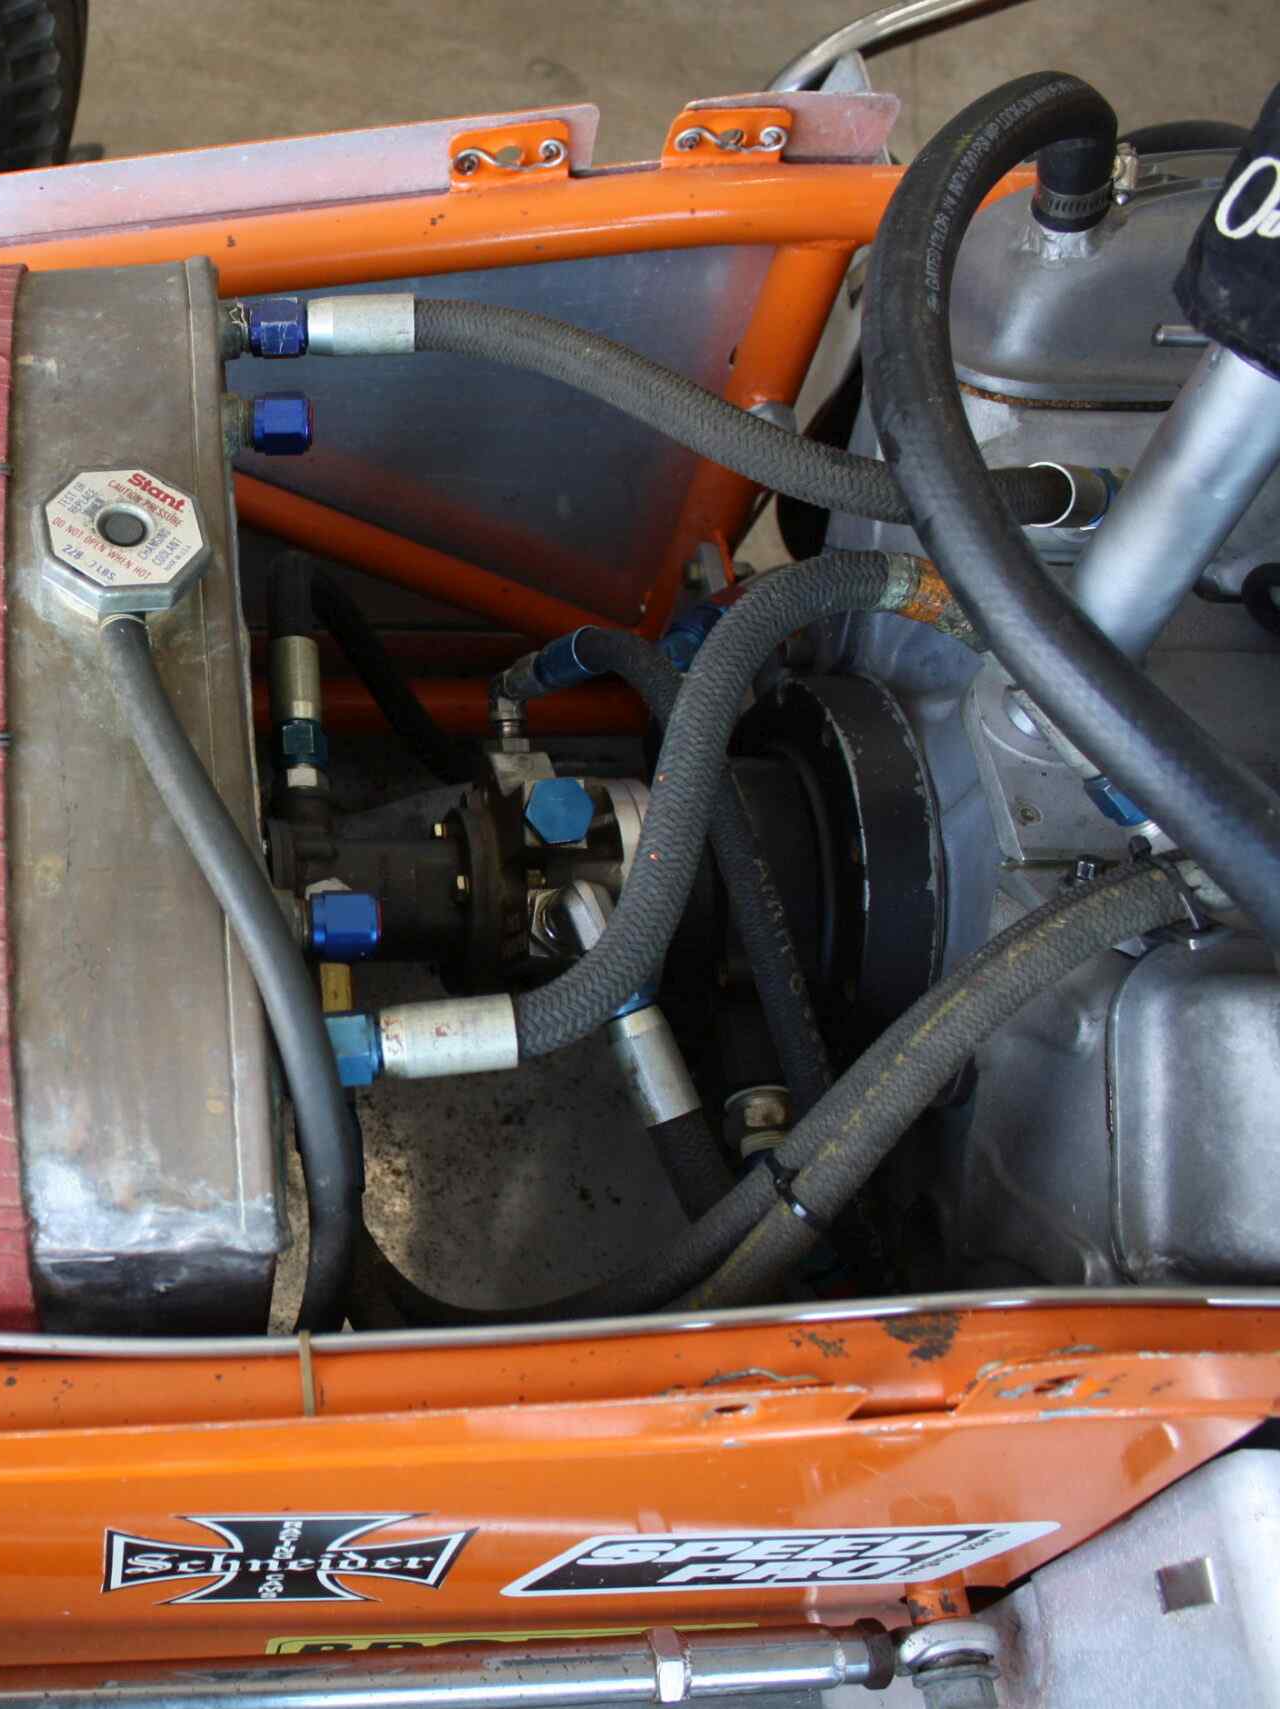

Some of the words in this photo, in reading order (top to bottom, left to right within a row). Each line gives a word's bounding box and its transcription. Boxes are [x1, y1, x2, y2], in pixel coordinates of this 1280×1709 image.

[129, 473, 186, 511] Stant
[83, 535, 106, 553] OPEN
[107, 549, 132, 569] WHEN
[133, 565, 151, 580] HOT
[124, 1550, 436, 1574] Schneider
[577, 1534, 968, 1565] SPEED
[657, 1557, 912, 1583] PRO
